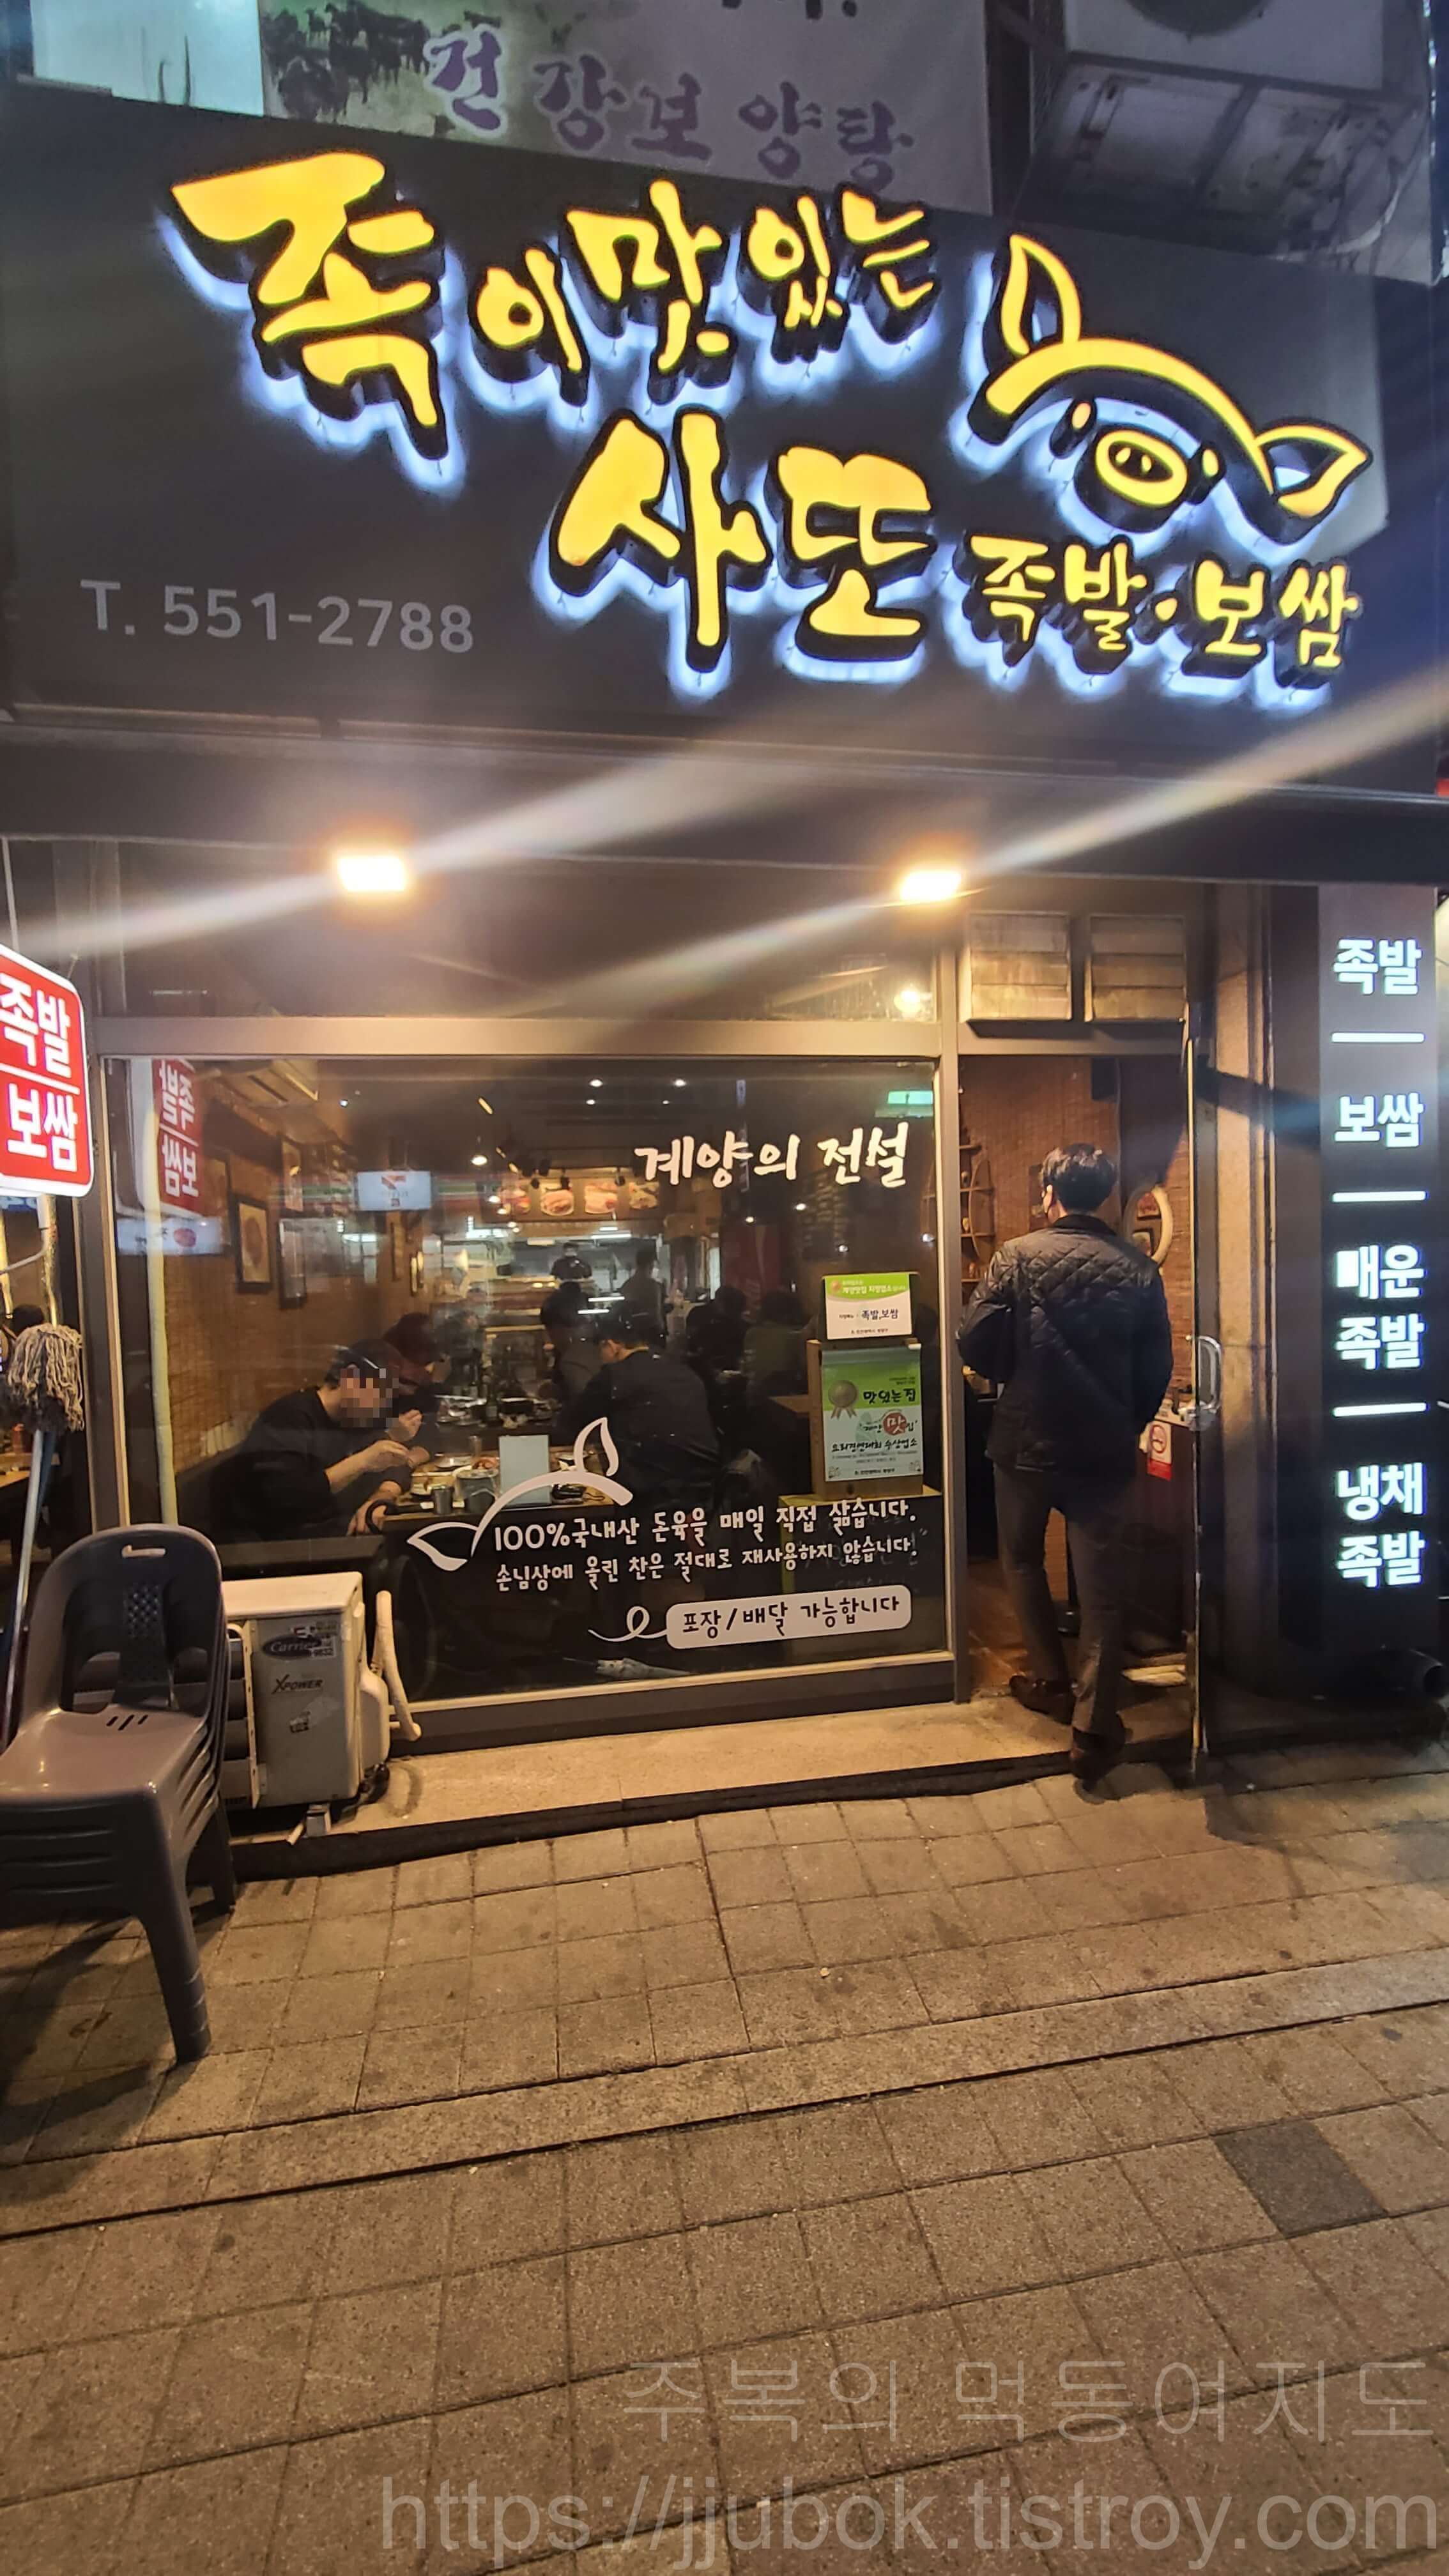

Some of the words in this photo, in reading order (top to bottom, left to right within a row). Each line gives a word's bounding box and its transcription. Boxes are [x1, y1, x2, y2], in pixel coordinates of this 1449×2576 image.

[557, 410, 931, 647] 사또
[80, 579, 136, 635] T.
[163, 585, 474, 653] 551-2788
[1332, 937, 1423, 995] 족발
[0, 972, 70, 1078] 족발
[7, 1083, 78, 1172] 보쌈
[1334, 1092, 1424, 1147] 보쌈
[635, 1130, 801, 1188] 계양의
[817, 1121, 908, 1188] 전설
[1336, 1243, 1425, 1300] 매운
[1335, 1314, 1425, 1370] 족발
[863, 1389, 901, 1404] 맛있는
[1337, 1462, 1424, 1521] 냉채
[494, 1517, 640, 1551] 100%국내산
[652, 1507, 707, 1547] 돈육을
[720, 1505, 764, 1542] 매일
[776, 1505, 816, 1533] 직접
[829, 1498, 916, 1536] 삶습니다.
[496, 1564, 573, 1591] 손님상에
[585, 1556, 618, 1590] 올린
[629, 1552, 664, 1581] 찬은
[674, 1549, 732, 1583] 절대로
[742, 1542, 832, 1570] 재사용하지
[843, 1535, 917, 1565] 않습니다.
[1338, 1531, 1425, 1588] 족발
[801, 1596, 900, 1628] 가능합니다
